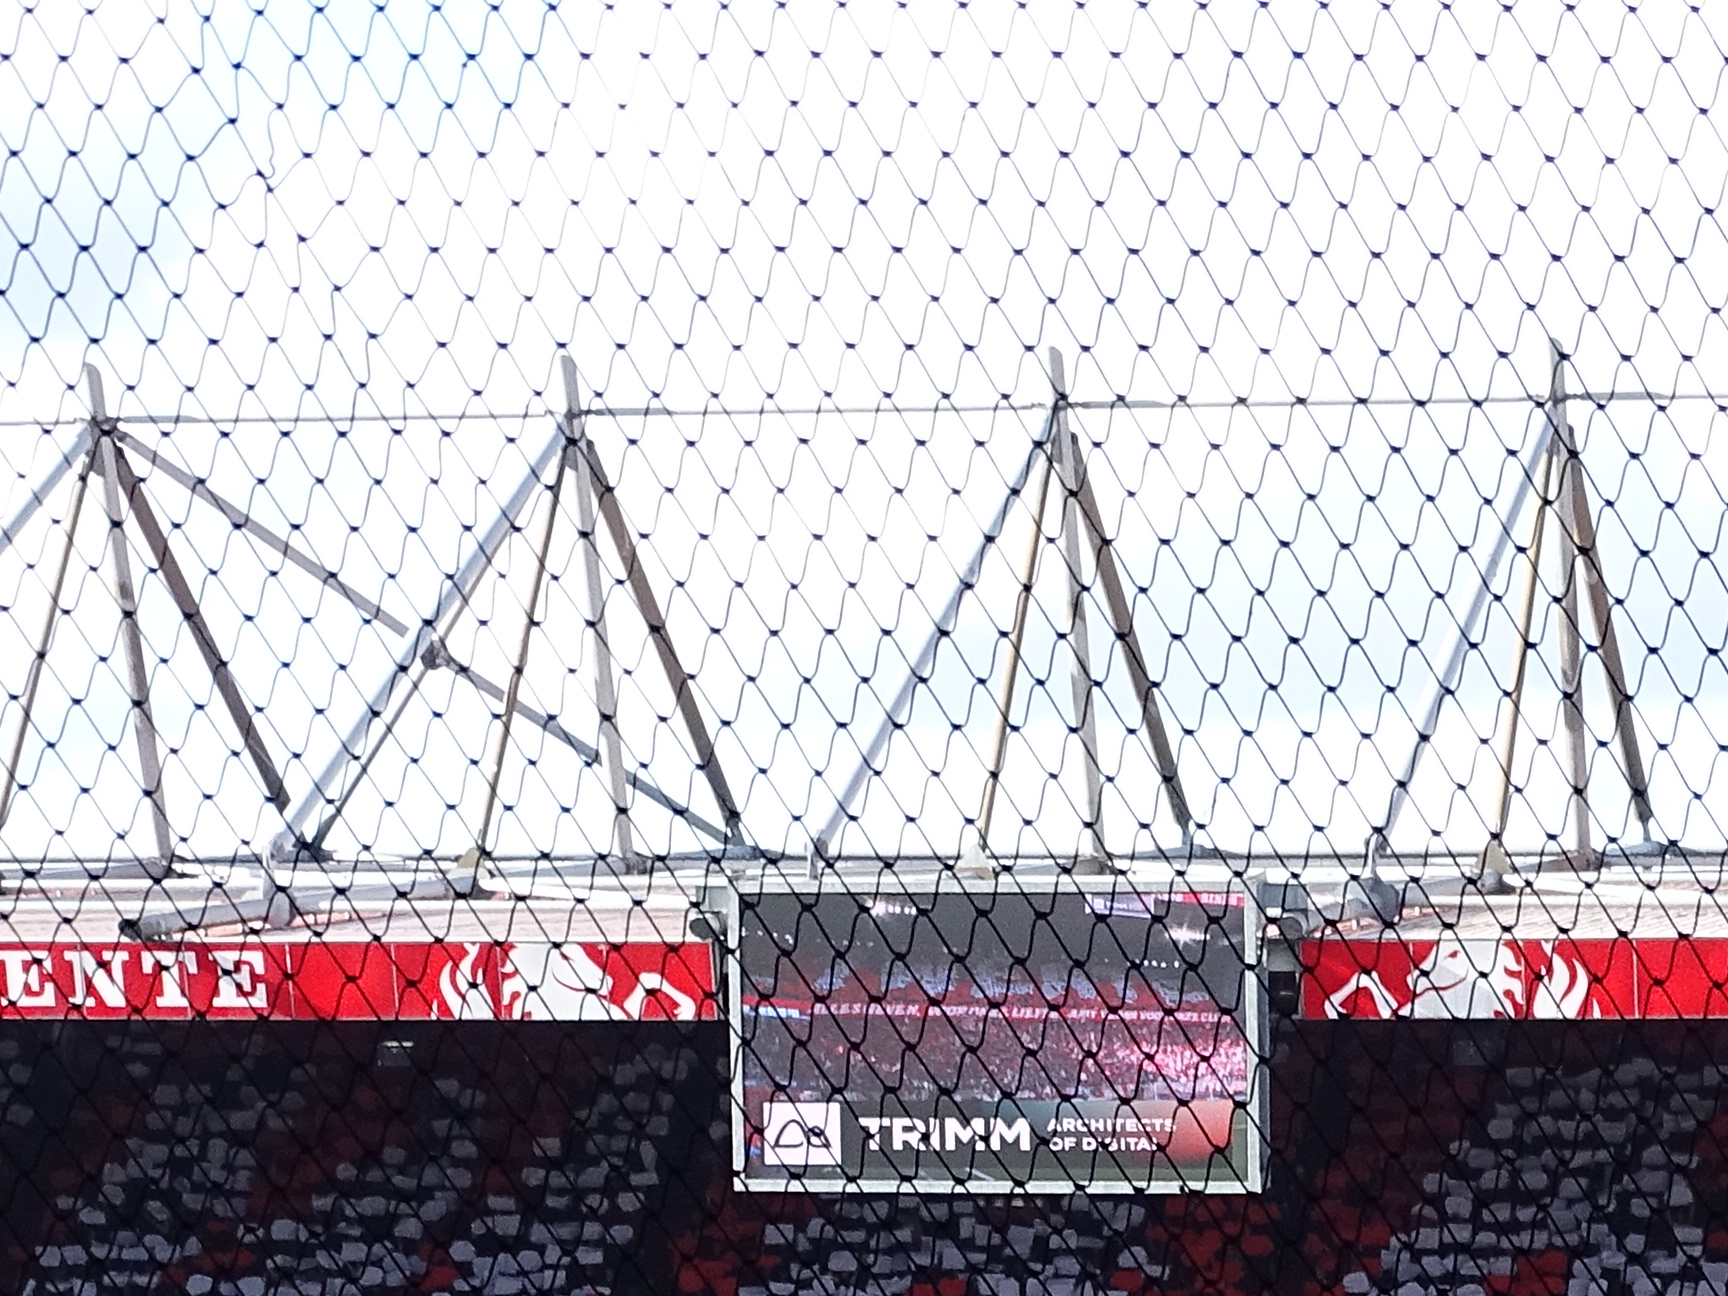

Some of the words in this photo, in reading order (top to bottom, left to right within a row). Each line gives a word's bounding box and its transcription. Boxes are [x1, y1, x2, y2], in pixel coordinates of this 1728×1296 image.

[1046, 1117, 1178, 1133] ARCHITECTS
[858, 1117, 1032, 1152] TRIMM
[1048, 1136, 1077, 1152] OF
[1083, 1136, 1160, 1152] DIGITAL
